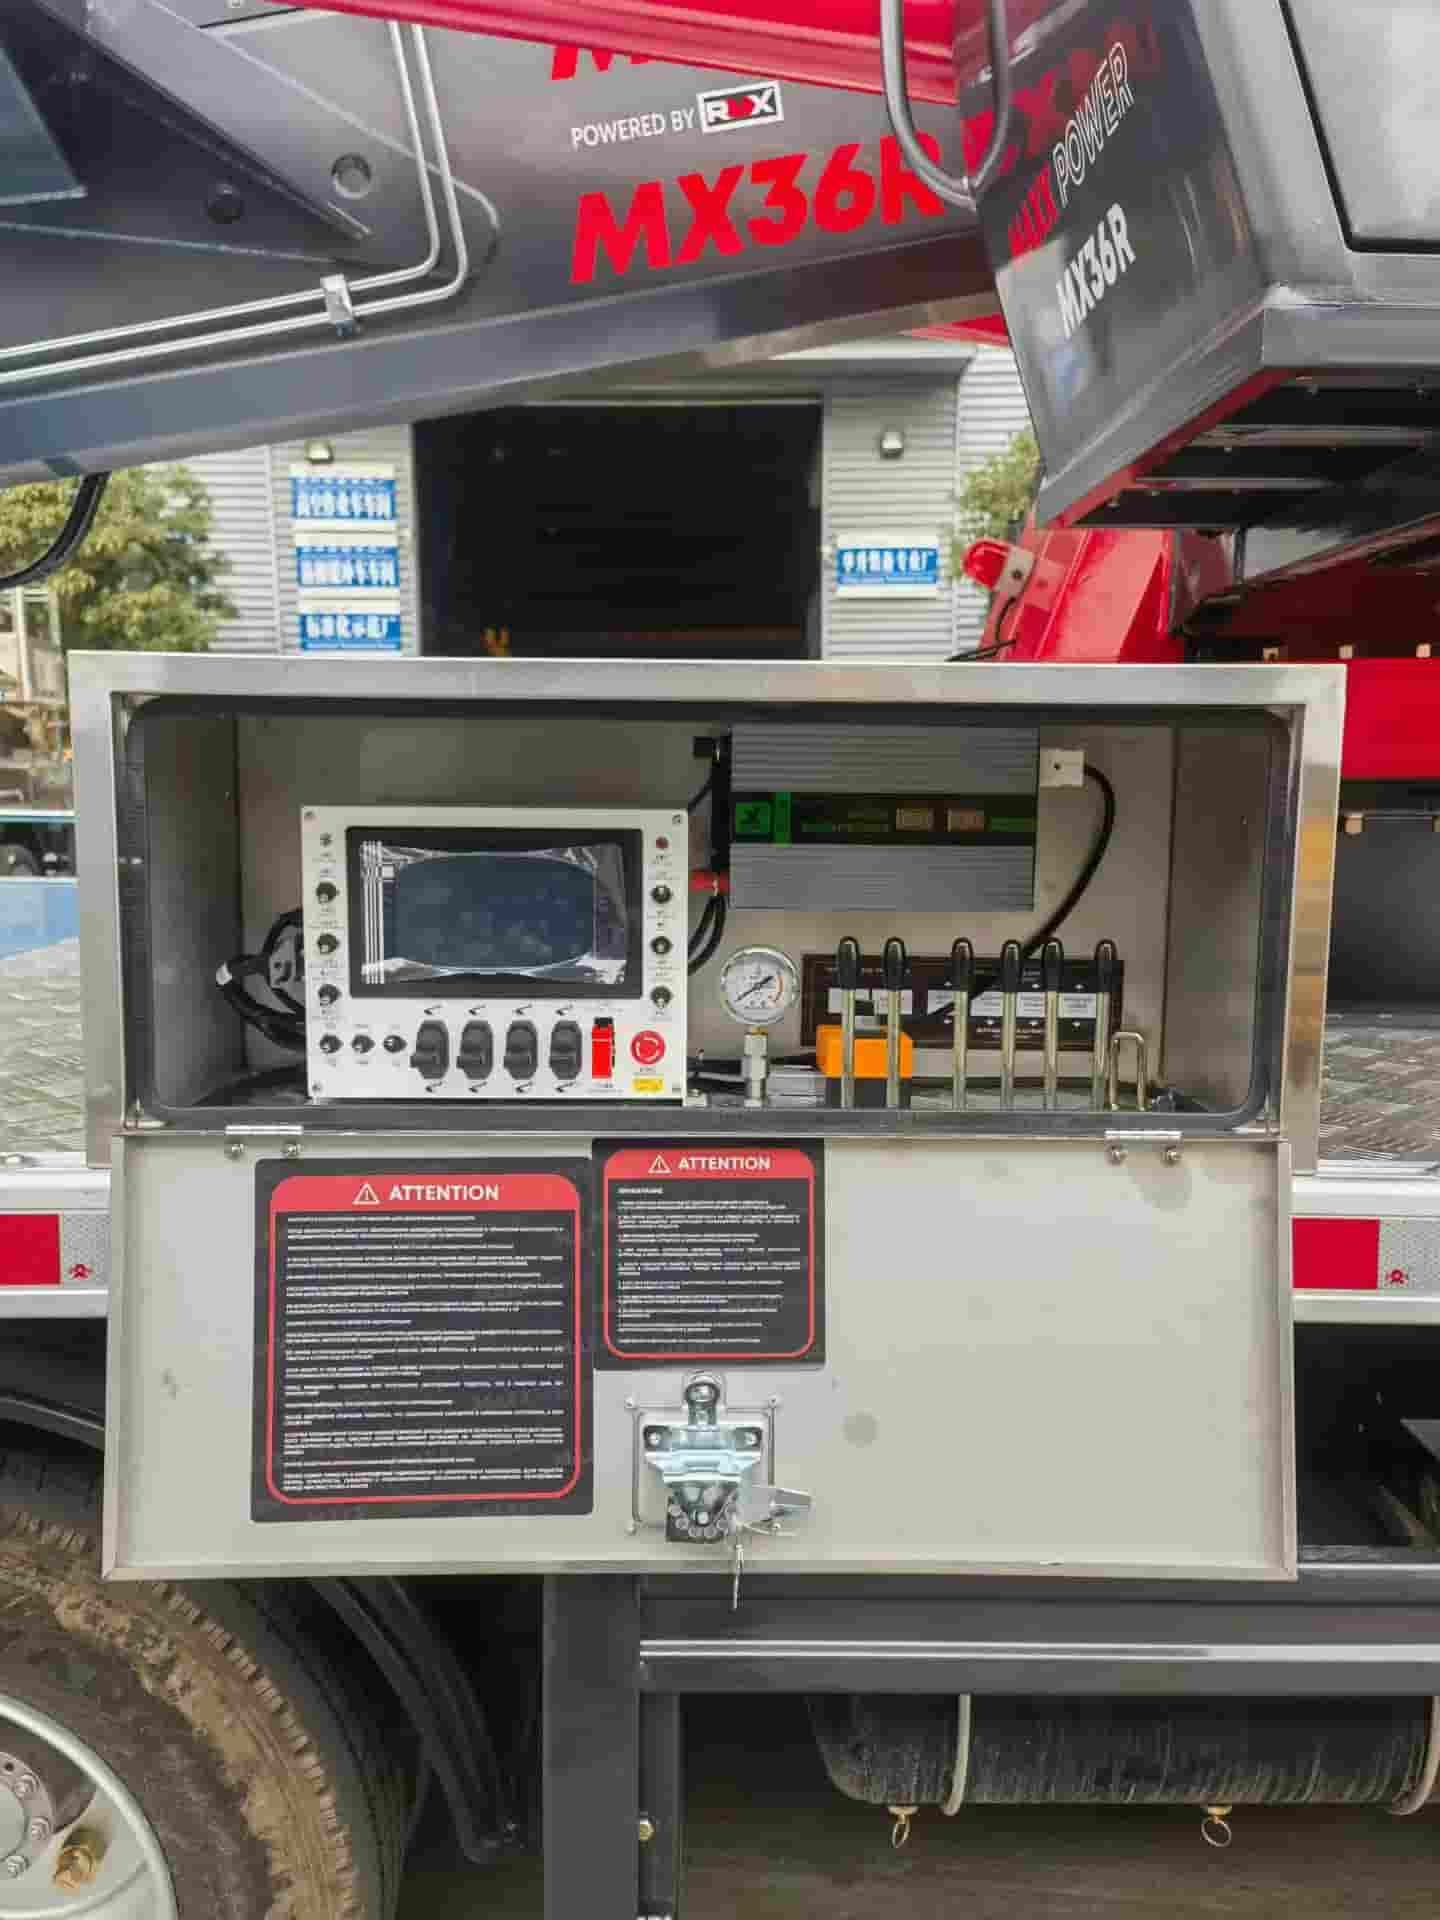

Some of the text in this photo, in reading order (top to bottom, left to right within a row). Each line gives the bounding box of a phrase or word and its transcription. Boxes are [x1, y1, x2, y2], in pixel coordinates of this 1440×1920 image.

[571, 112, 665, 149] POWERED
[671, 107, 695, 132] BY
[1053, 42, 1134, 208] POWER
[569, 130, 946, 285] MX36R
[1056, 203, 1137, 340] MX36R
[389, 1184, 500, 1202] ATTENTION
[678, 1156, 771, 1170] ATTENTION
